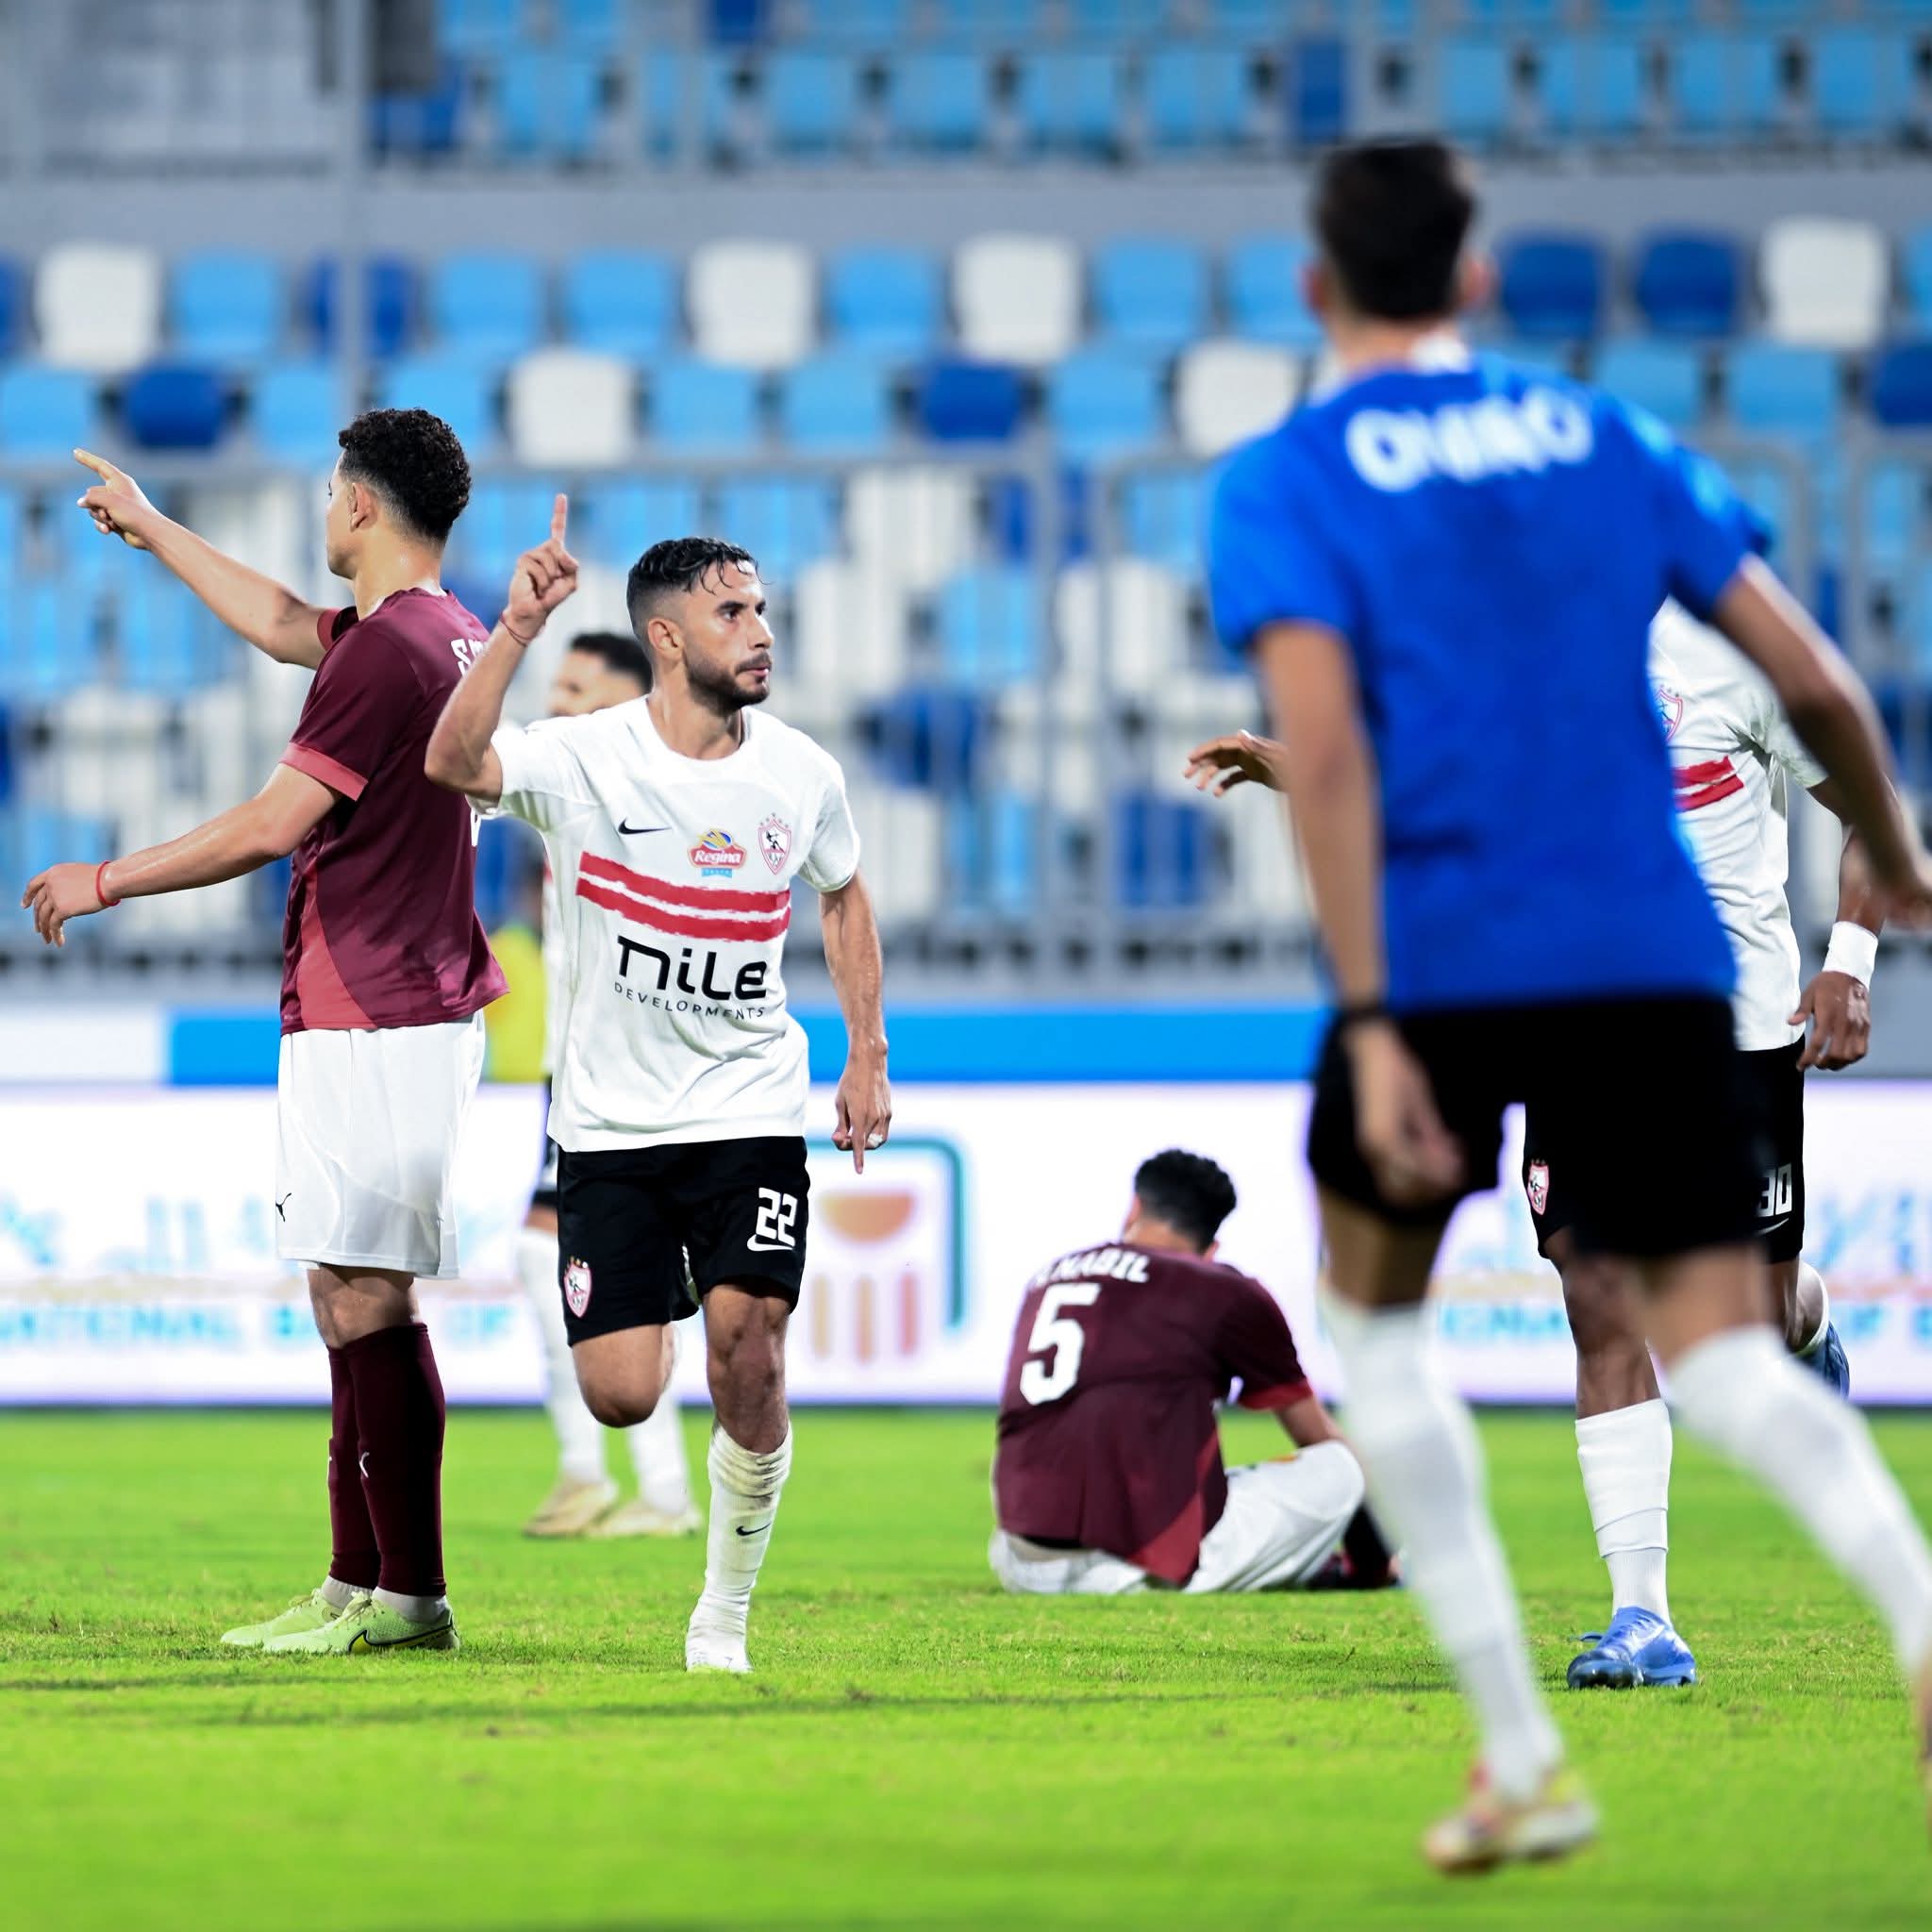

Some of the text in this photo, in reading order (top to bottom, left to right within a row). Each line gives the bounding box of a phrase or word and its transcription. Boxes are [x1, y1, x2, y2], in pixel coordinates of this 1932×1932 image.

[694, 849, 741, 865] Regina
[614, 981, 766, 1020] DEVELOPMENTS
[756, 1187, 798, 1247] 22
[1020, 1282, 1102, 1406] 5
